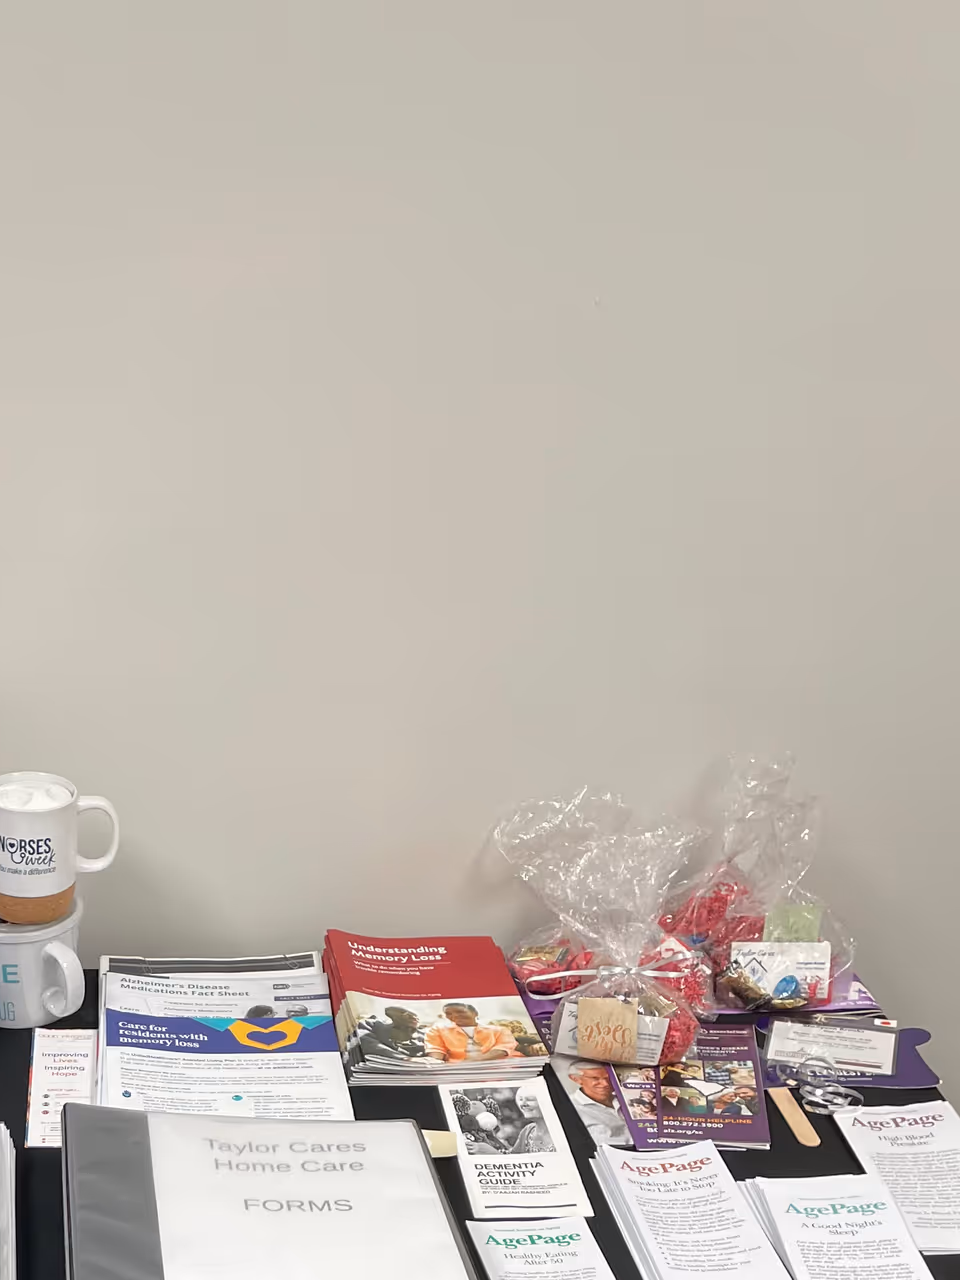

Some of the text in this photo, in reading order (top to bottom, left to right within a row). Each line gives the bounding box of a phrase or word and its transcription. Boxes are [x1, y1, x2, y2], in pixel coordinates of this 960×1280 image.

[348, 941, 447, 954] Understanding
[352, 949, 408, 963] Memory
[120, 977, 184, 989] Alzheimer's
[120, 984, 188, 995] Medications
[118, 1021, 168, 1032] Care for
[119, 1029, 208, 1041] residents with
[120, 1036, 200, 1048] memory loss
[852, 1113, 945, 1131] AgePage
[905, 1132, 935, 1140] Blood
[202, 1137, 367, 1156] Taylor Cares
[214, 1158, 365, 1173] Home Care
[474, 1162, 544, 1170] DEMENTIA
[620, 1157, 712, 1177] AgePage
[690, 1173, 720, 1184] Never
[692, 1181, 715, 1190] Stop
[243, 1198, 353, 1212] FORMS
[784, 1201, 887, 1219] AgePage
[845, 1220, 883, 1229] Night's
[485, 1233, 581, 1249] AgePage
[504, 1252, 541, 1260] Healthy
